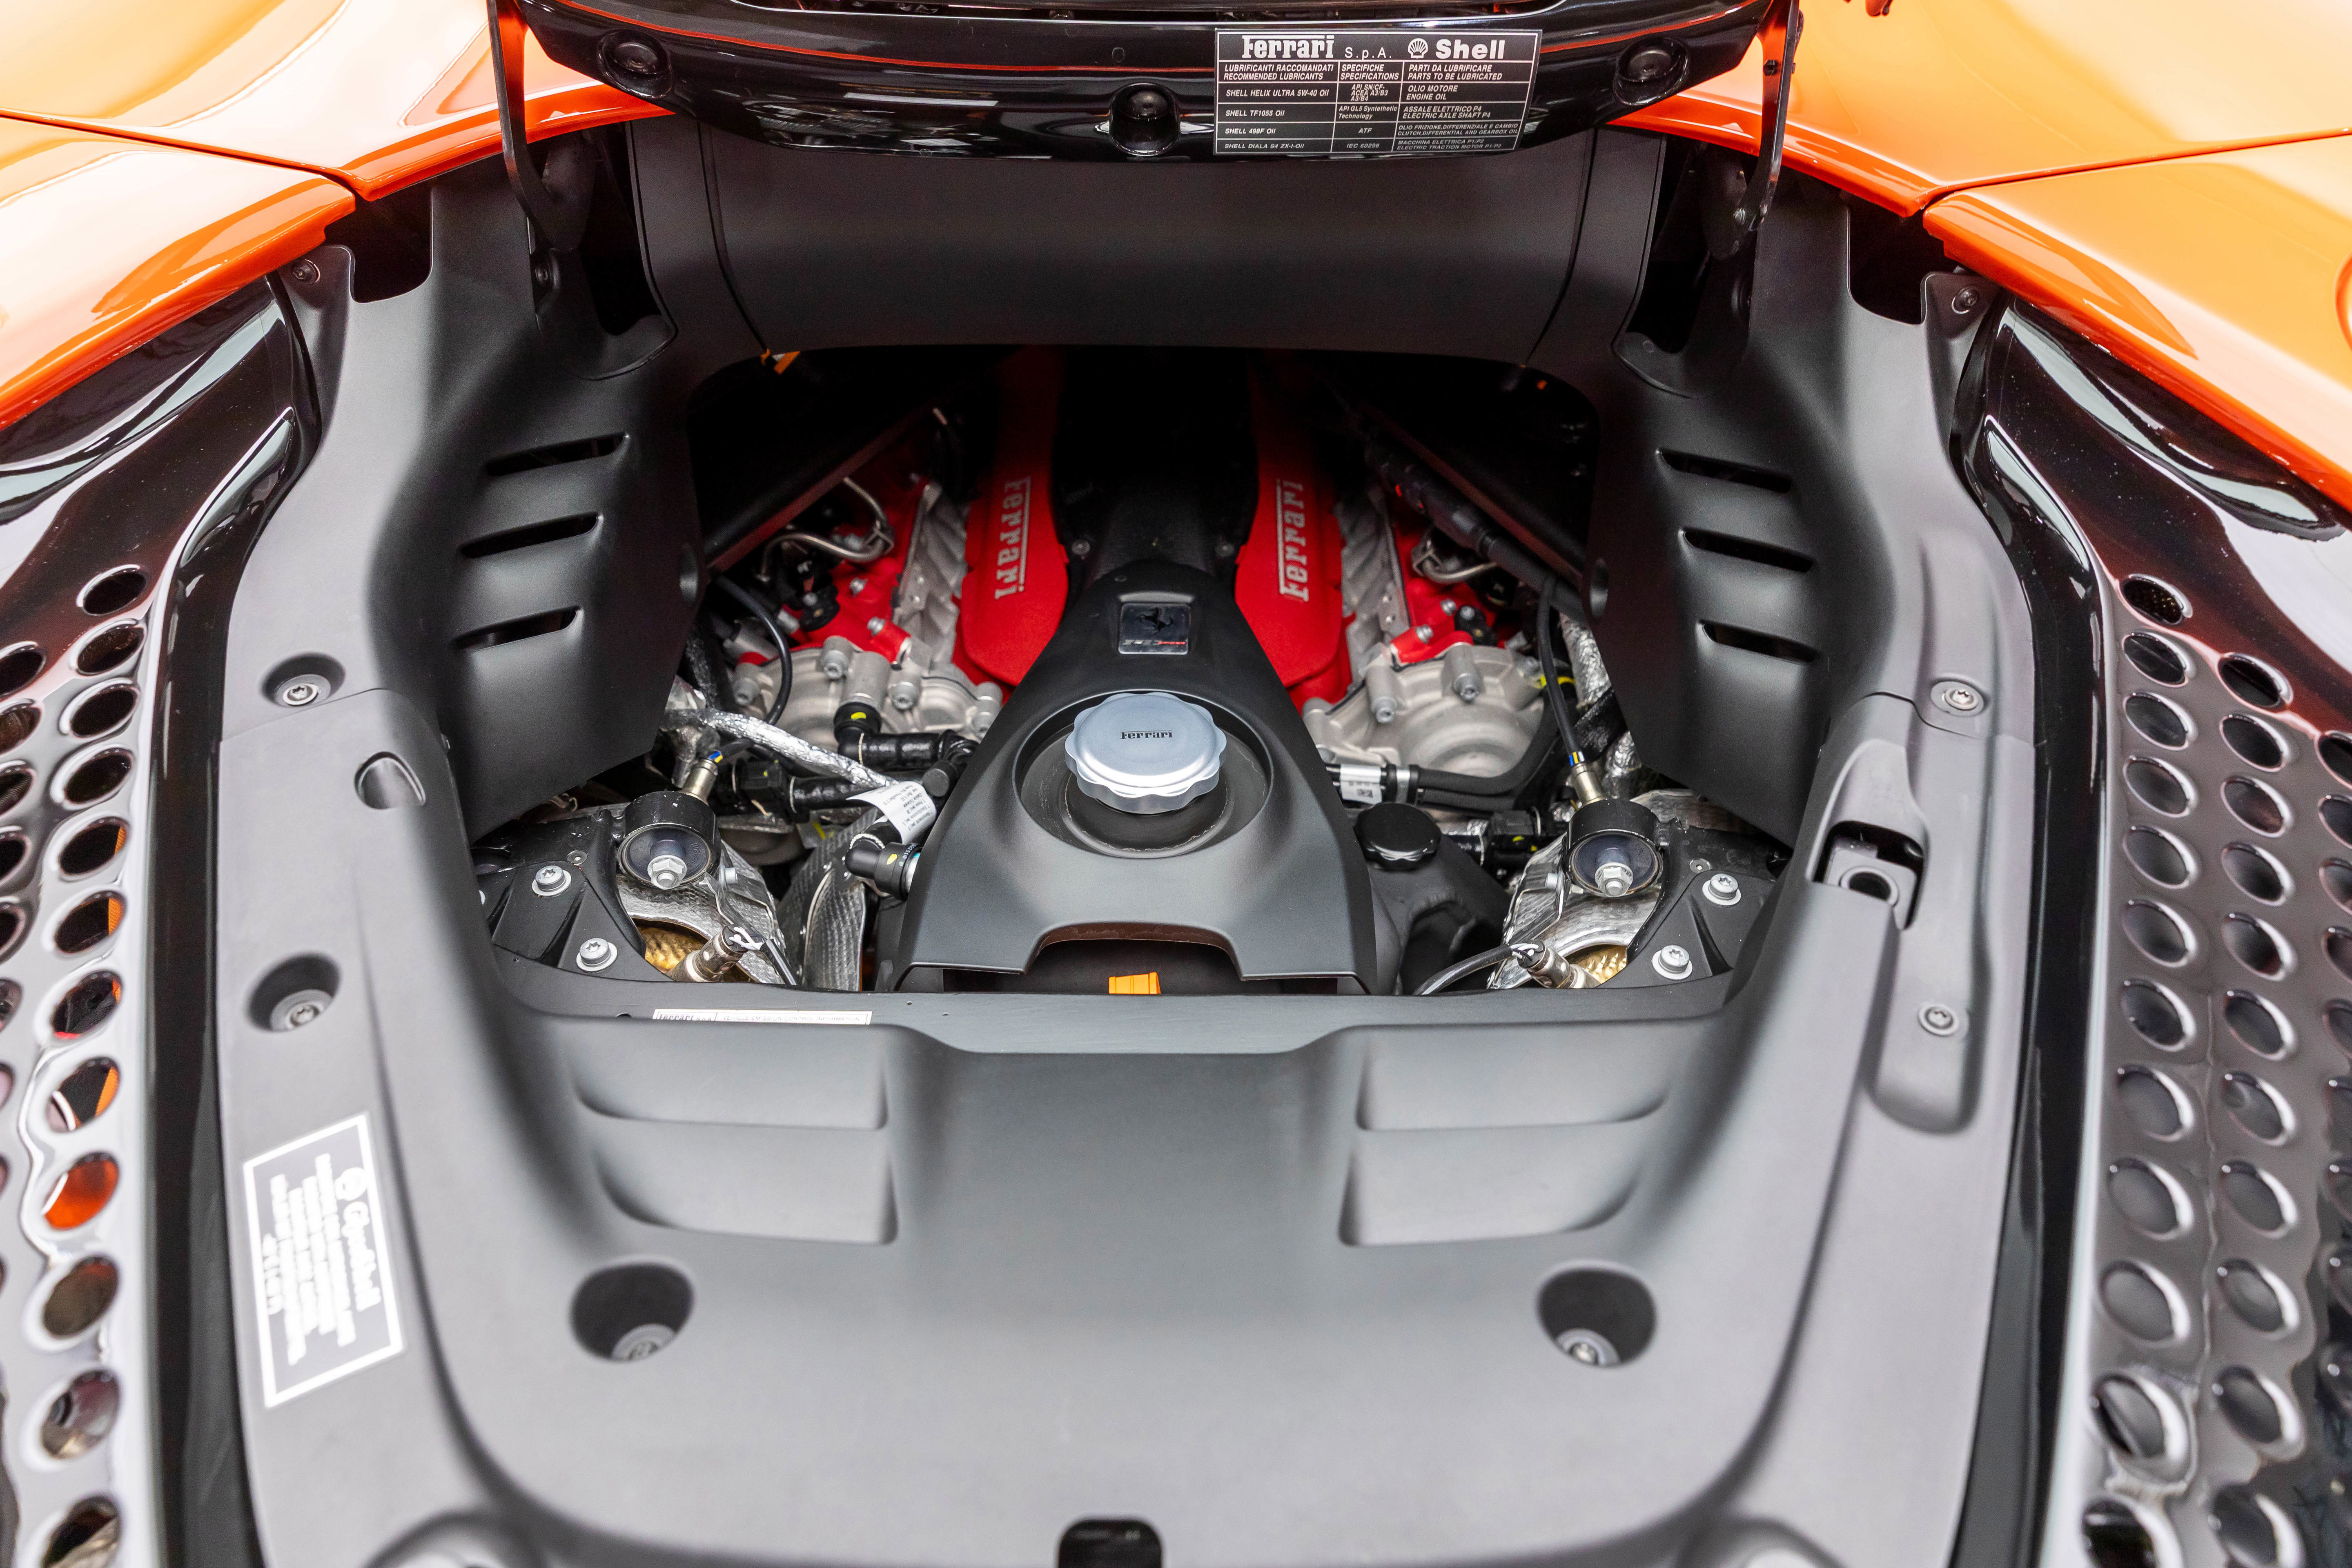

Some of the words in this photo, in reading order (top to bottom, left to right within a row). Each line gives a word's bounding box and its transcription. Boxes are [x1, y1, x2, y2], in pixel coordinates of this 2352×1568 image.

[1242, 35, 1334, 58] Ferrari
[1345, 47, 1392, 60] S.p.A.
[1435, 39, 1505, 59] Shell
[994, 476, 1031, 600] Ferrari
[1276, 478, 1309, 602] Ferrari
[1120, 730, 1173, 739] Ferrari
